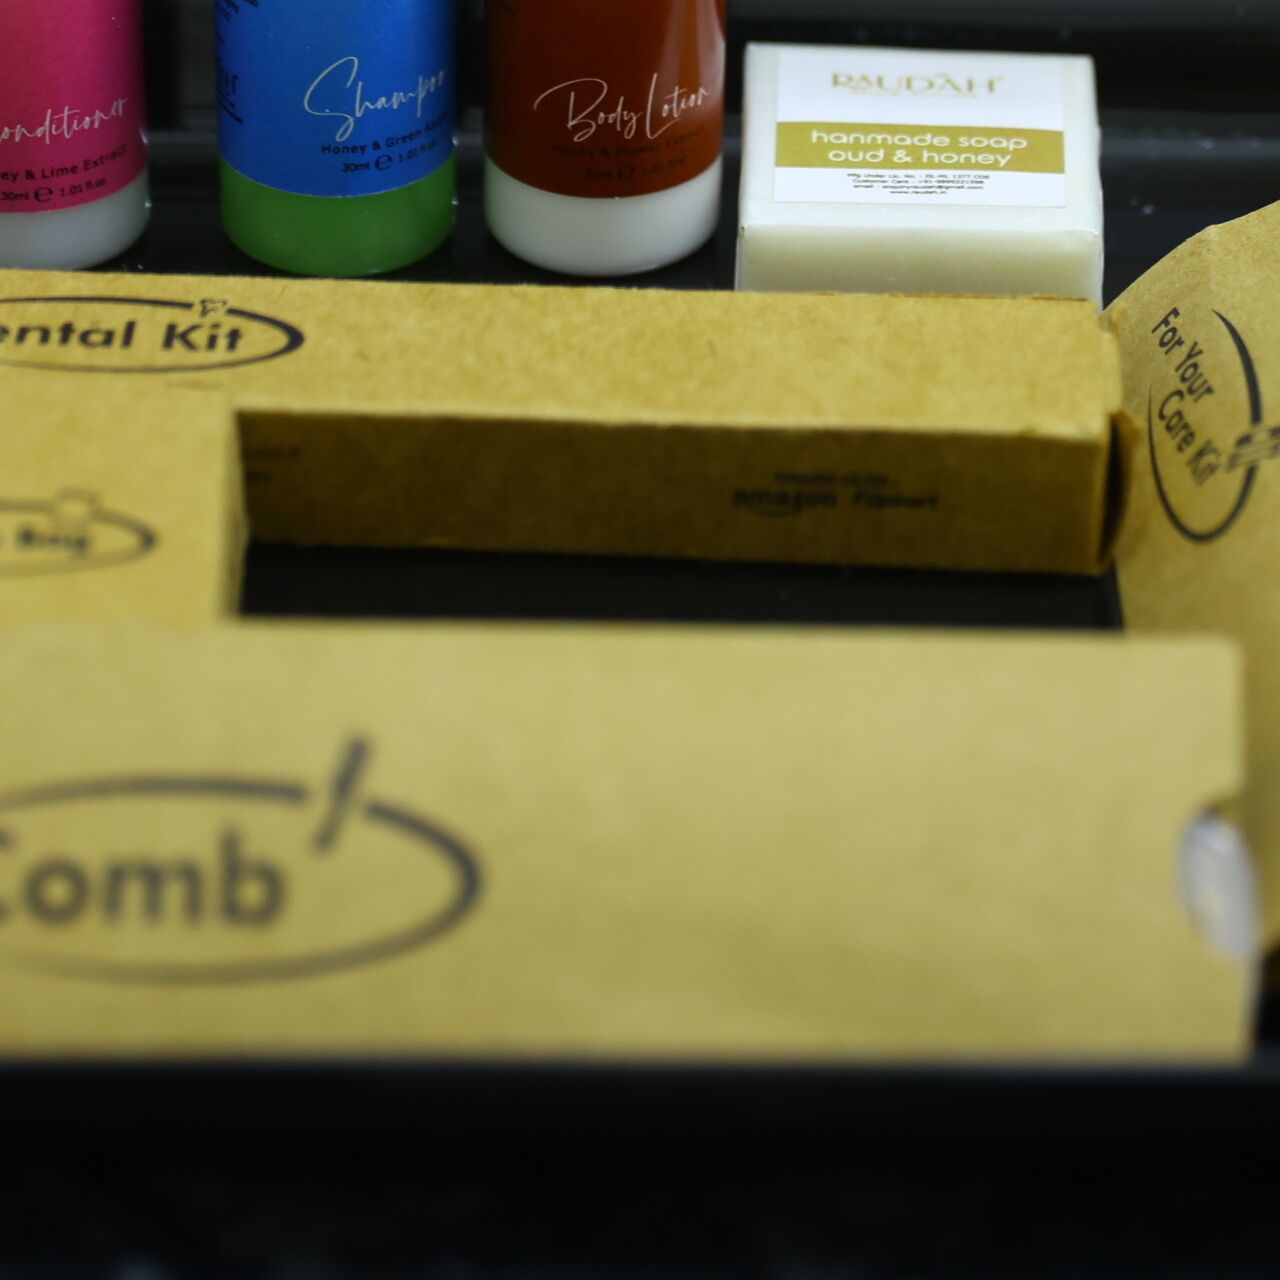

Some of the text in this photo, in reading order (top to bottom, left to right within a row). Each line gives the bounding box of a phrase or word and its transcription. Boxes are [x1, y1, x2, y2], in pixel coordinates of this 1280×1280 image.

[303, 56, 446, 142] Shampoo
[533, 73, 712, 142] Body Lotion
[320, 143, 368, 156] Honey
[371, 140, 382, 151] &
[811, 129, 1028, 151] hanmade soap
[828, 148, 1012, 167] oud & honey
[24, 169, 36, 180] &
[41, 164, 79, 179] Lime
[83, 144, 129, 171] Extract
[161, 322, 247, 353] Kit
[1151, 306, 1215, 403] For Your
[1157, 388, 1222, 486] Care Kit
